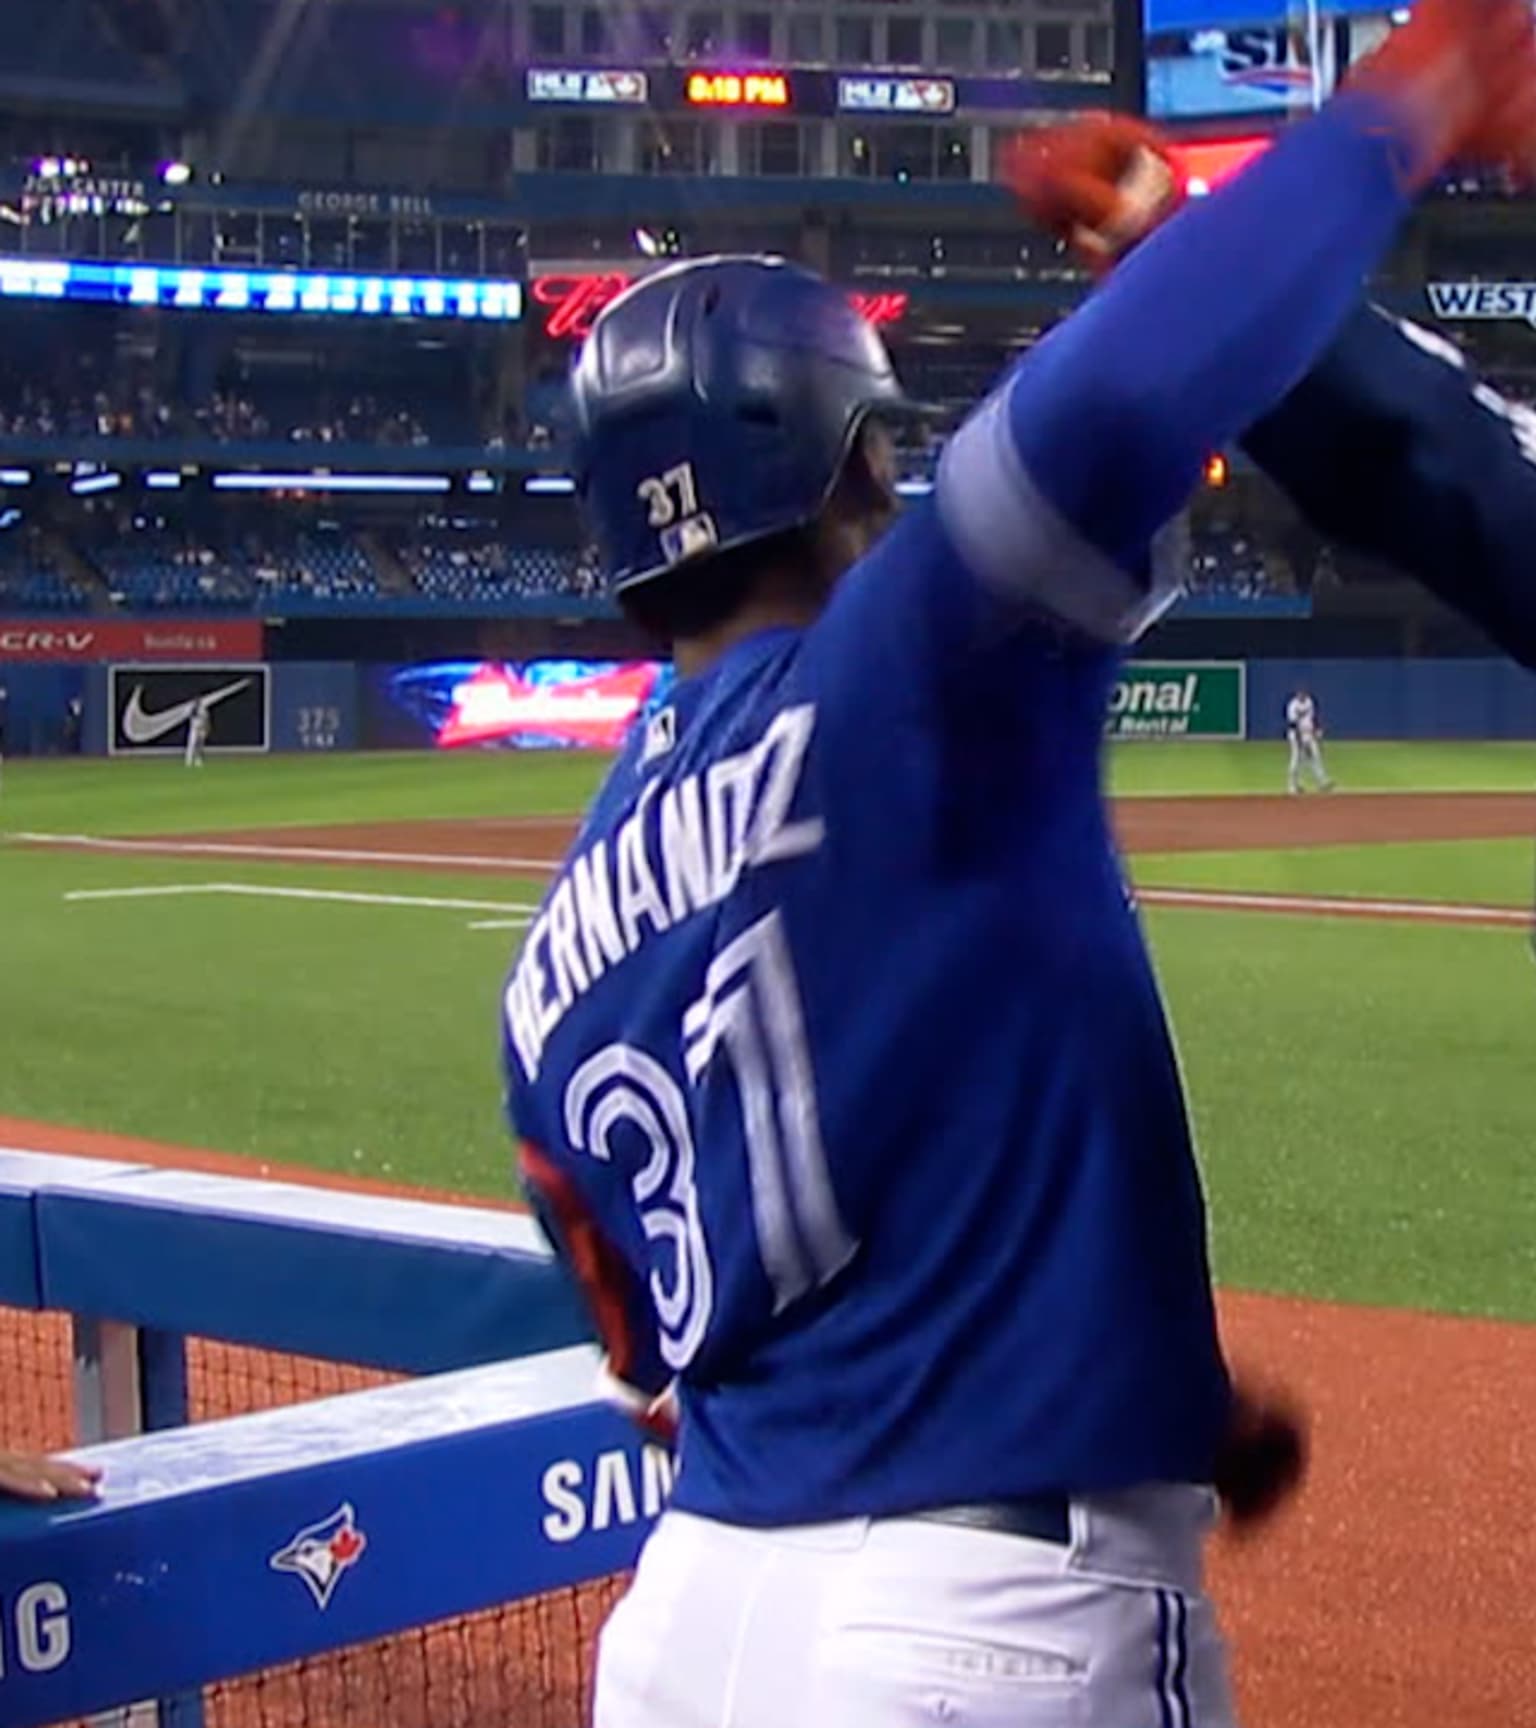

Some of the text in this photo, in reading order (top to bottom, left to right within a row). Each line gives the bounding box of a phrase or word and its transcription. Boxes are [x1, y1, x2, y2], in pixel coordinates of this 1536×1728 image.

[745, 75, 787, 104] PM
[636, 460, 698, 528] 37
[1120, 715, 1189, 734] Rental
[505, 702, 826, 1084] HERNÁNDZ
[564, 907, 862, 1370] 37
